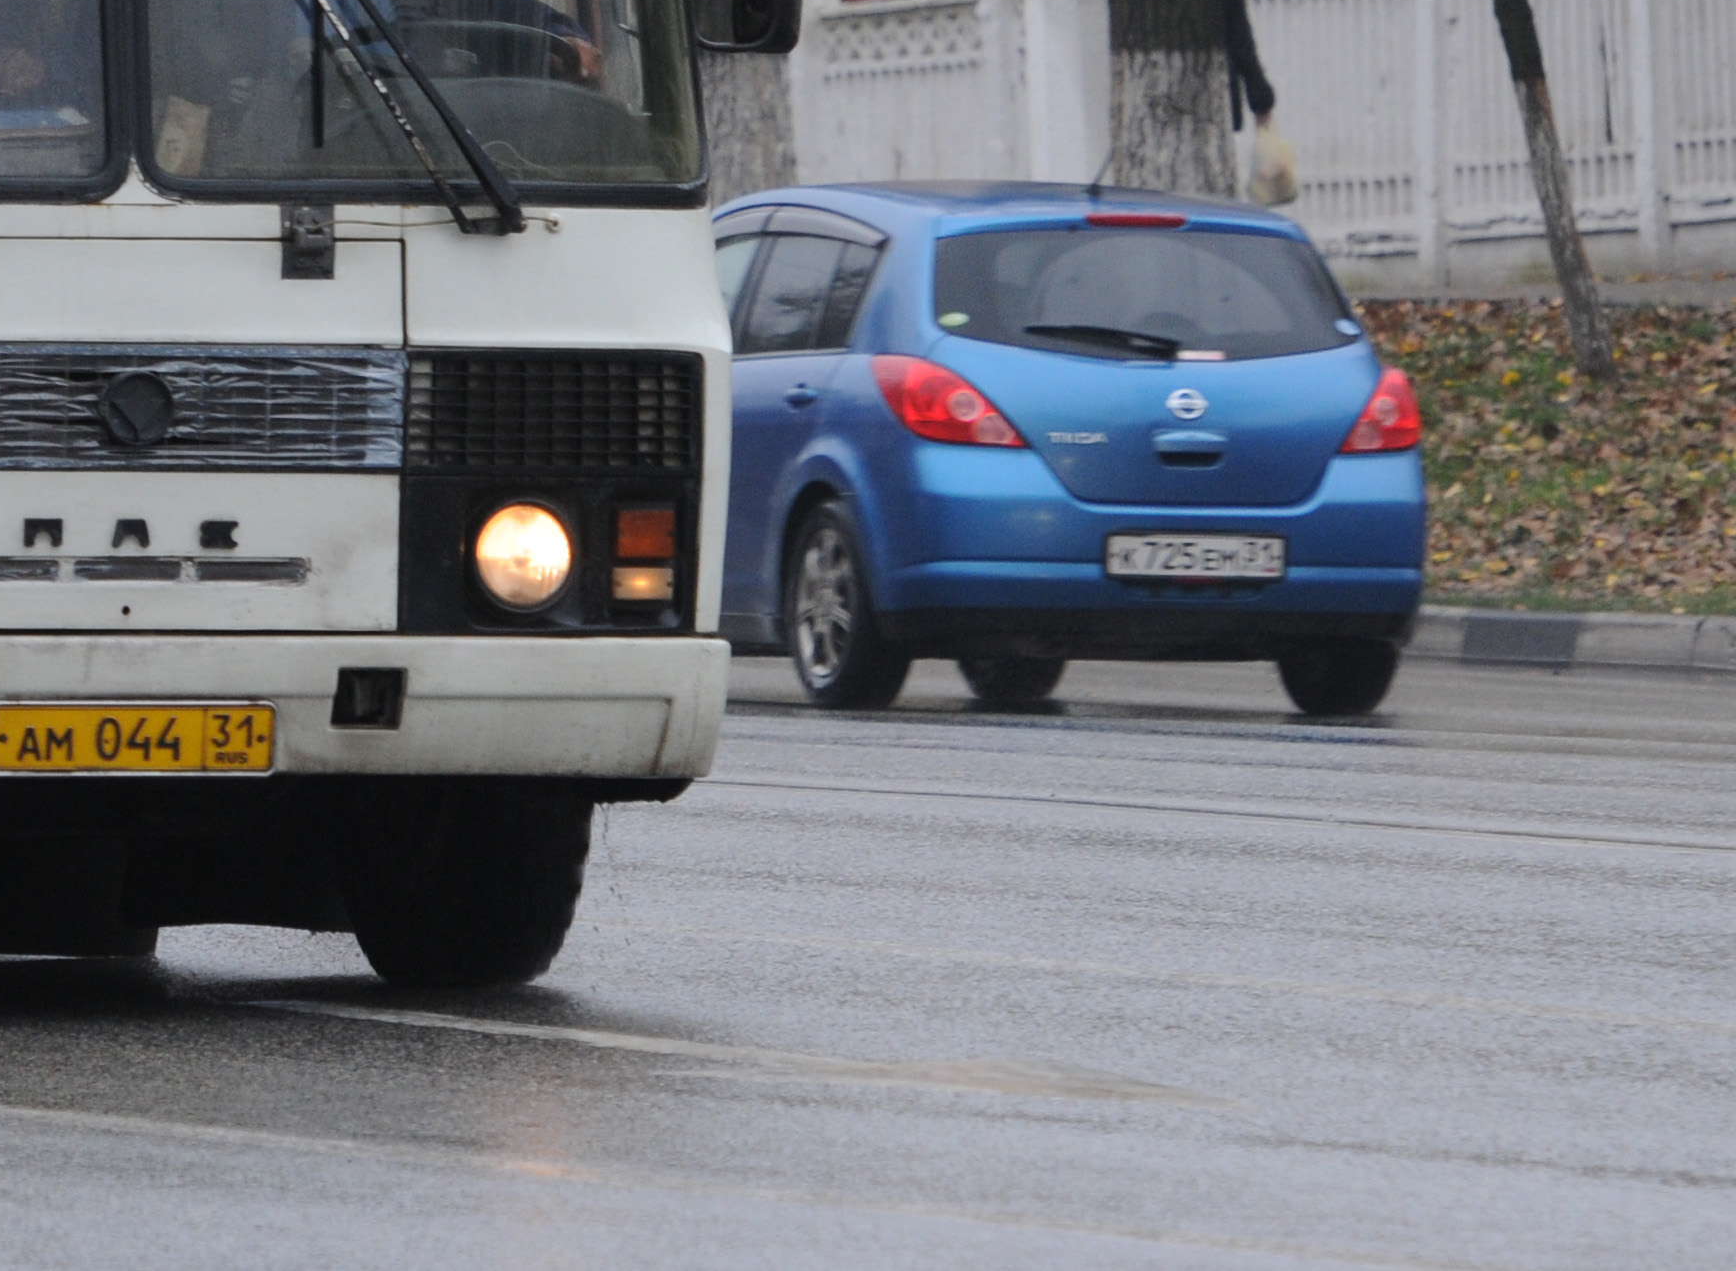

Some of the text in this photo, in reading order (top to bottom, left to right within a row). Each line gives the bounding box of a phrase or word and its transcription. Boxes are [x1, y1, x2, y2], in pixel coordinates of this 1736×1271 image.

[95, 716, 182, 762] 044
[211, 714, 256, 749] 31
[214, 751, 250, 765] RUS
